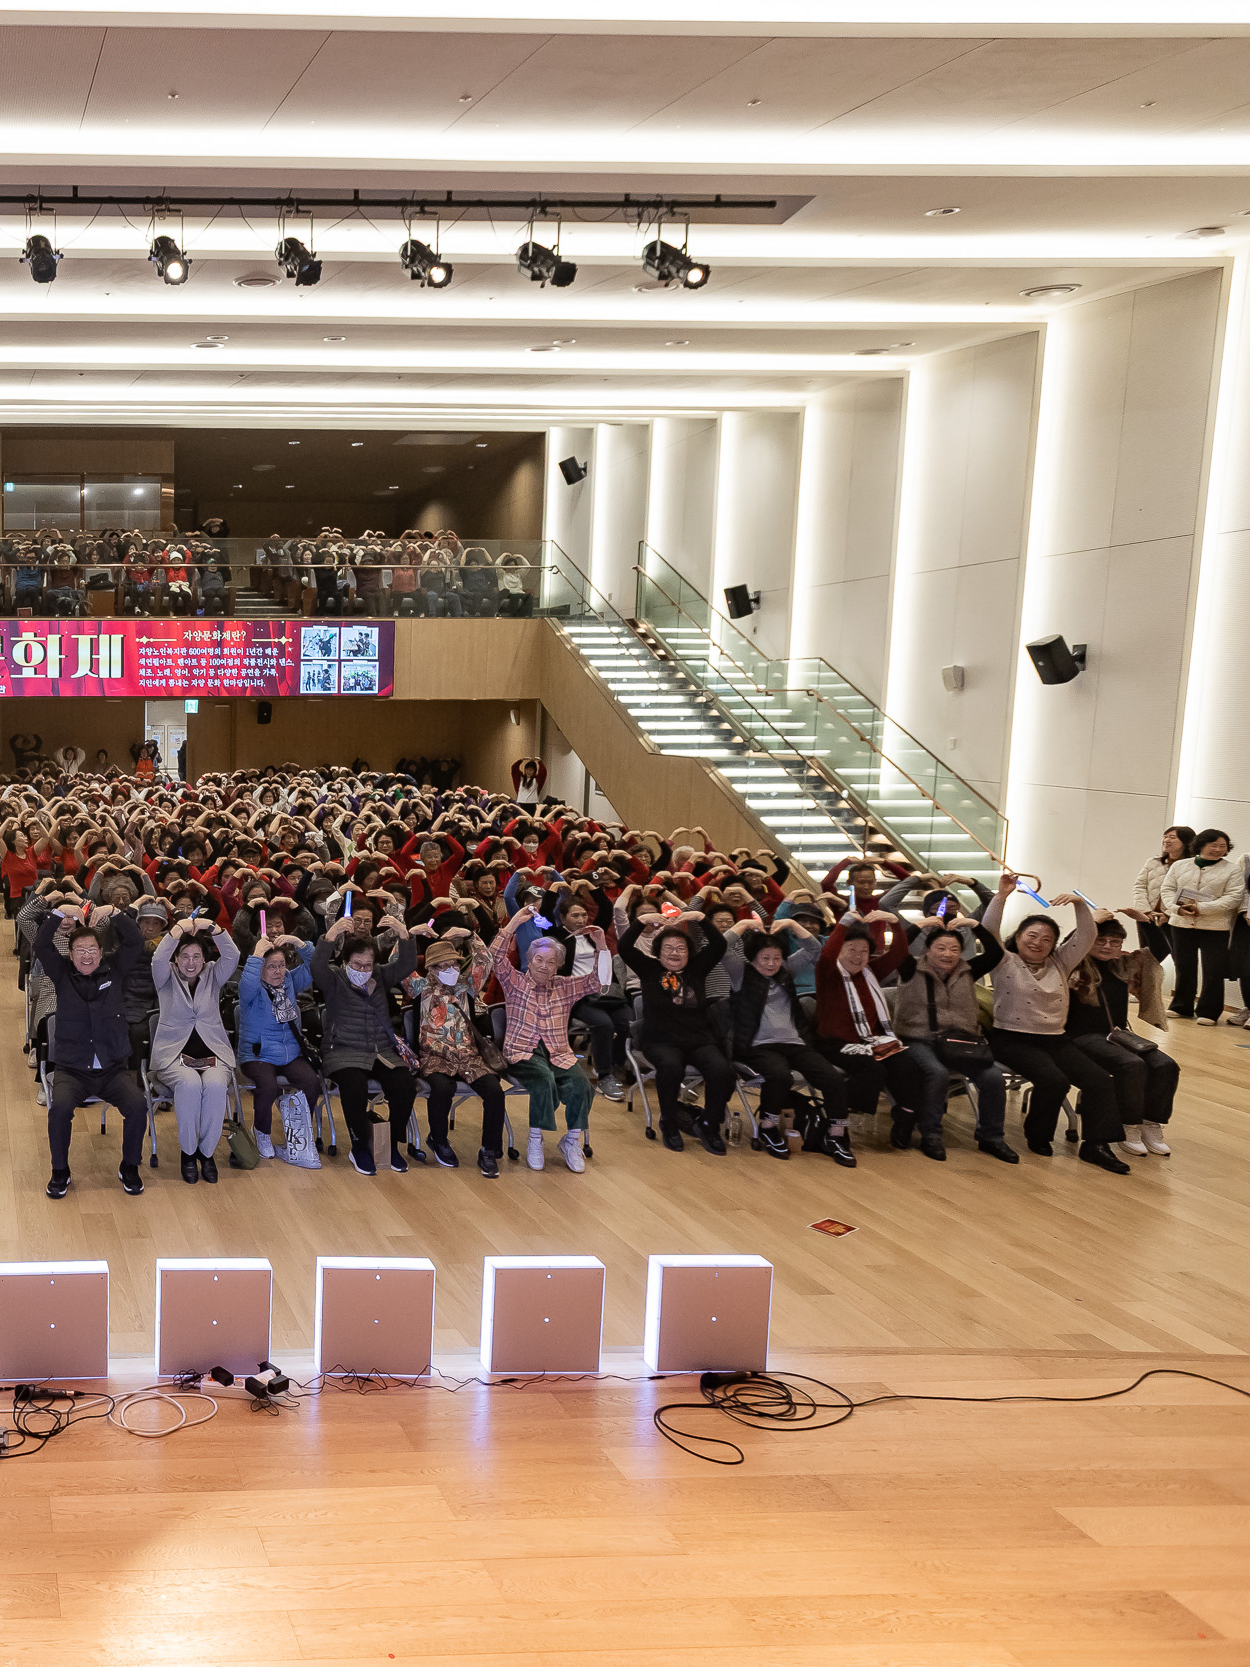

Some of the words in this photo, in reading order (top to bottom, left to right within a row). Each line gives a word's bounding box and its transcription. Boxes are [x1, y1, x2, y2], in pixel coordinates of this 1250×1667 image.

[183, 630, 246, 642] 자양문화제란?
[138, 647, 187, 656] 자양노인복지관
[188, 647, 221, 656] 600여명의
[223, 647, 244, 656] 회원이
[245, 647, 263, 656] 1년간
[265, 647, 279, 656] 배운
[200, 657, 208, 667] 등
[209, 657, 241, 667] 100여점의
[243, 657, 278, 667] 작품전시와
[193, 668, 207, 677] 악기
[209, 668, 216, 677] 등
[218, 668, 239, 677] 다양한
[240, 668, 262, 677] 공연을
[138, 678, 166, 688] 지인에게
[167, 678, 190, 688] 뽐내는
[191, 678, 206, 688] 자양
[207, 678, 222, 688] 문화
[223, 678, 266, 688] 한마당입니다.
